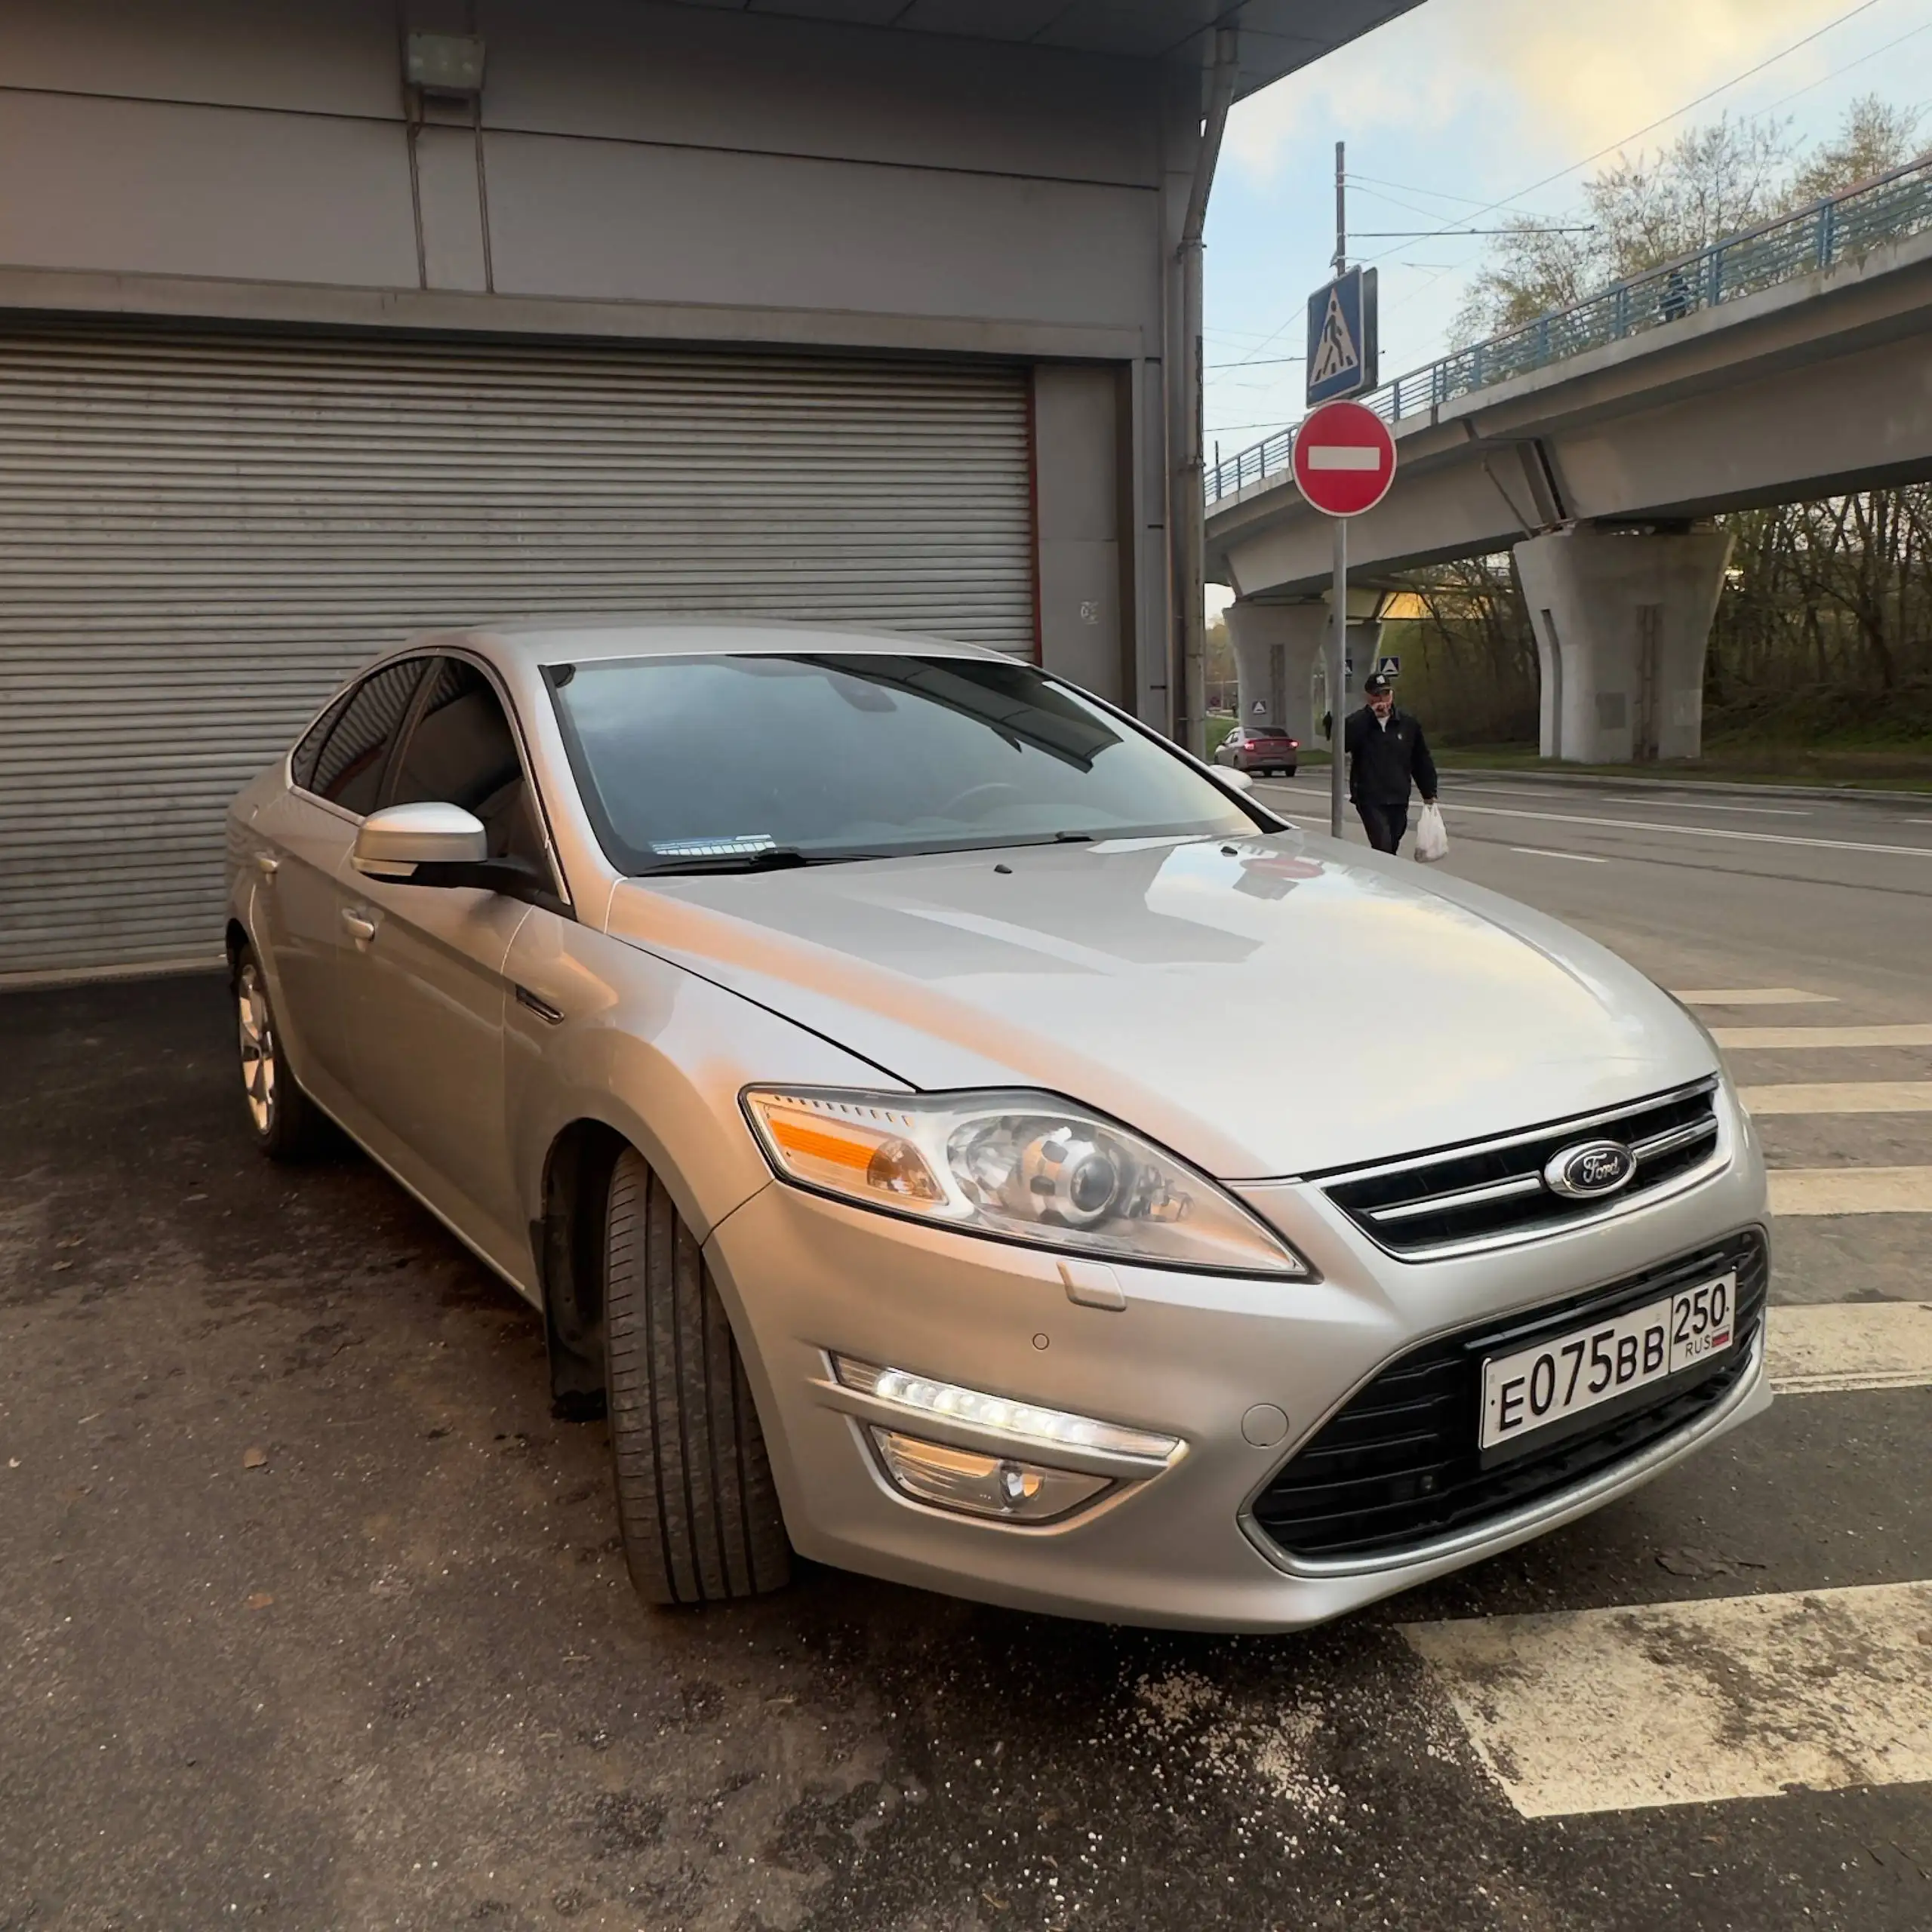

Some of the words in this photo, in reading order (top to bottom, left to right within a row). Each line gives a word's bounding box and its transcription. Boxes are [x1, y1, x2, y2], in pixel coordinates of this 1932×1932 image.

[1583, 1152, 1620, 1183] Ford
[1673, 1283, 1726, 1344] 250
[1684, 1334, 1711, 1358] RUS
